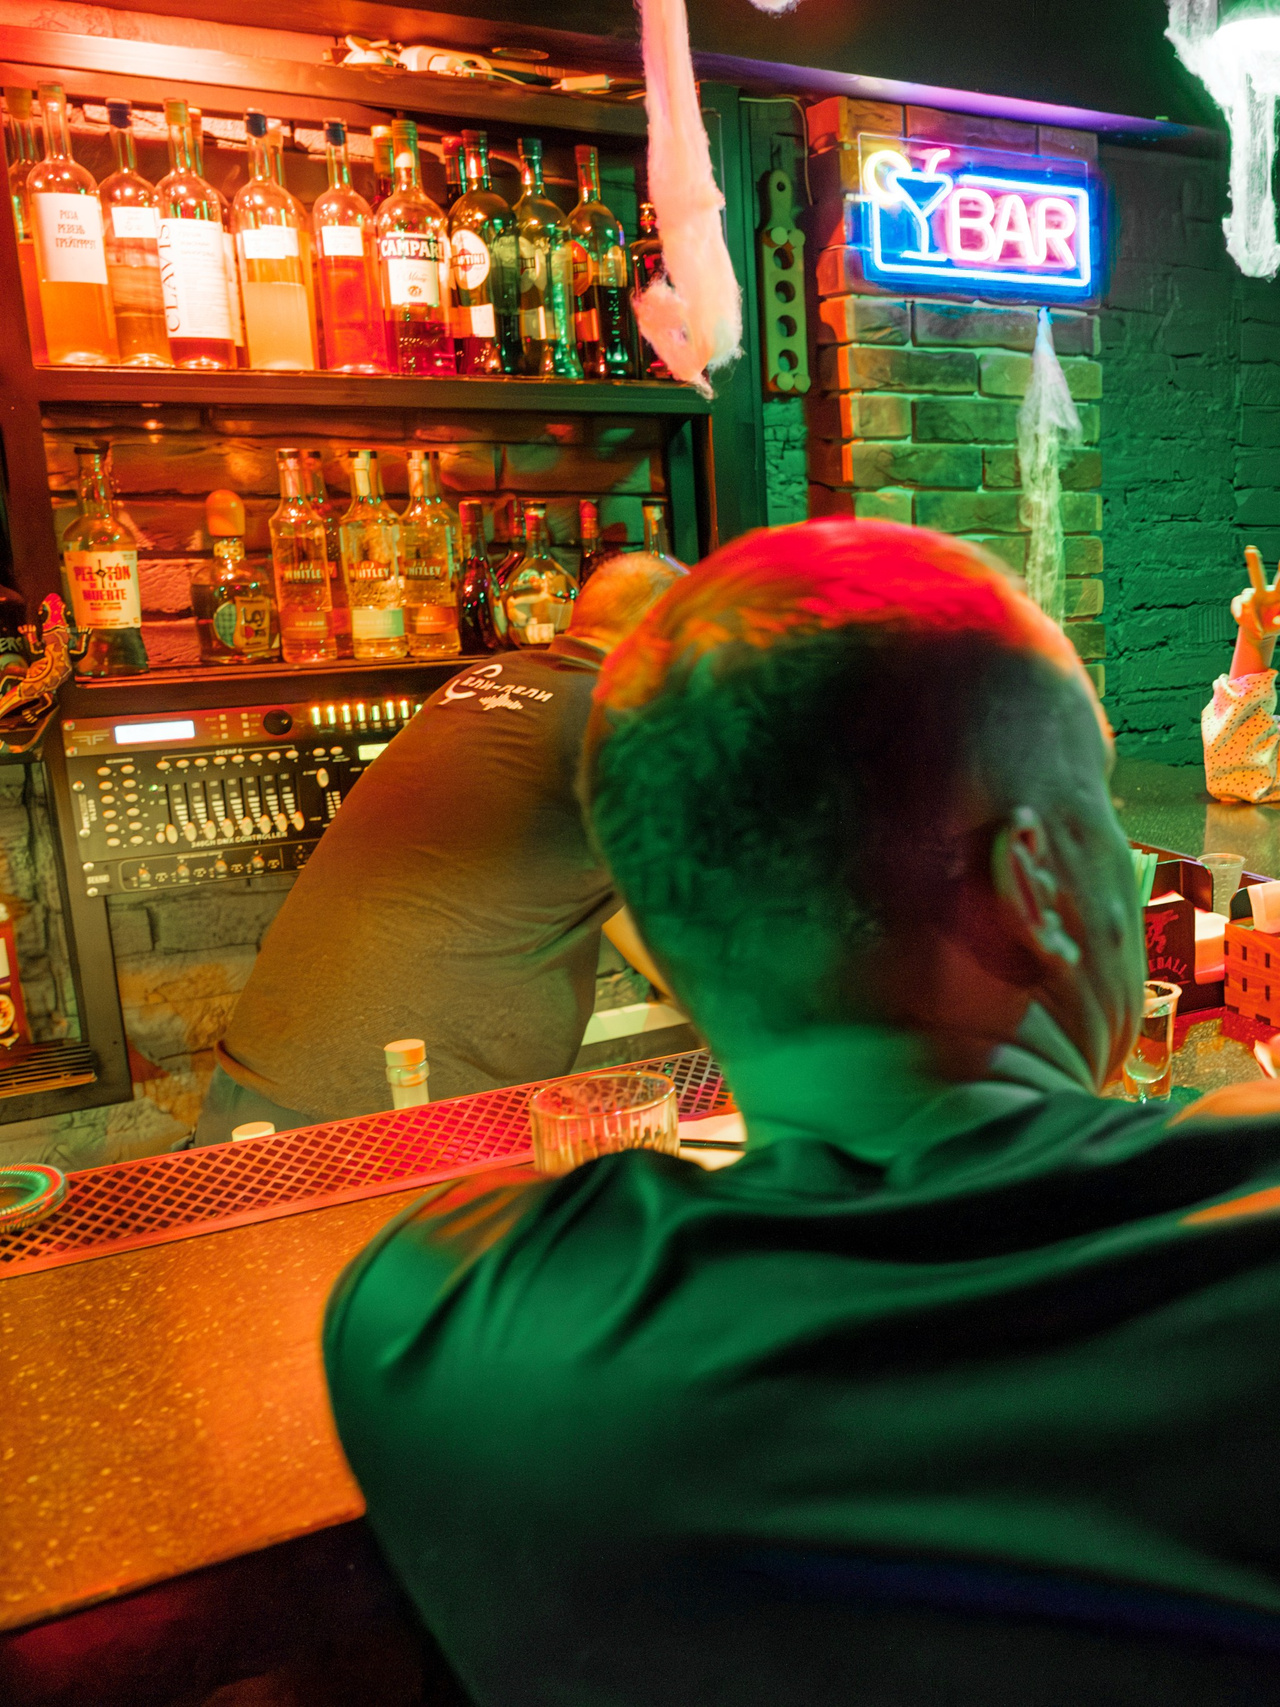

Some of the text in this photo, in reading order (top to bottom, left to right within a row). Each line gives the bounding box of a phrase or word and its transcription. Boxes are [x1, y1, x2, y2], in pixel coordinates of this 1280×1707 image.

[381, 239, 444, 259] CAMPARI
[951, 187, 1077, 270] BAR
[159, 224, 181, 332] CLAVIS
